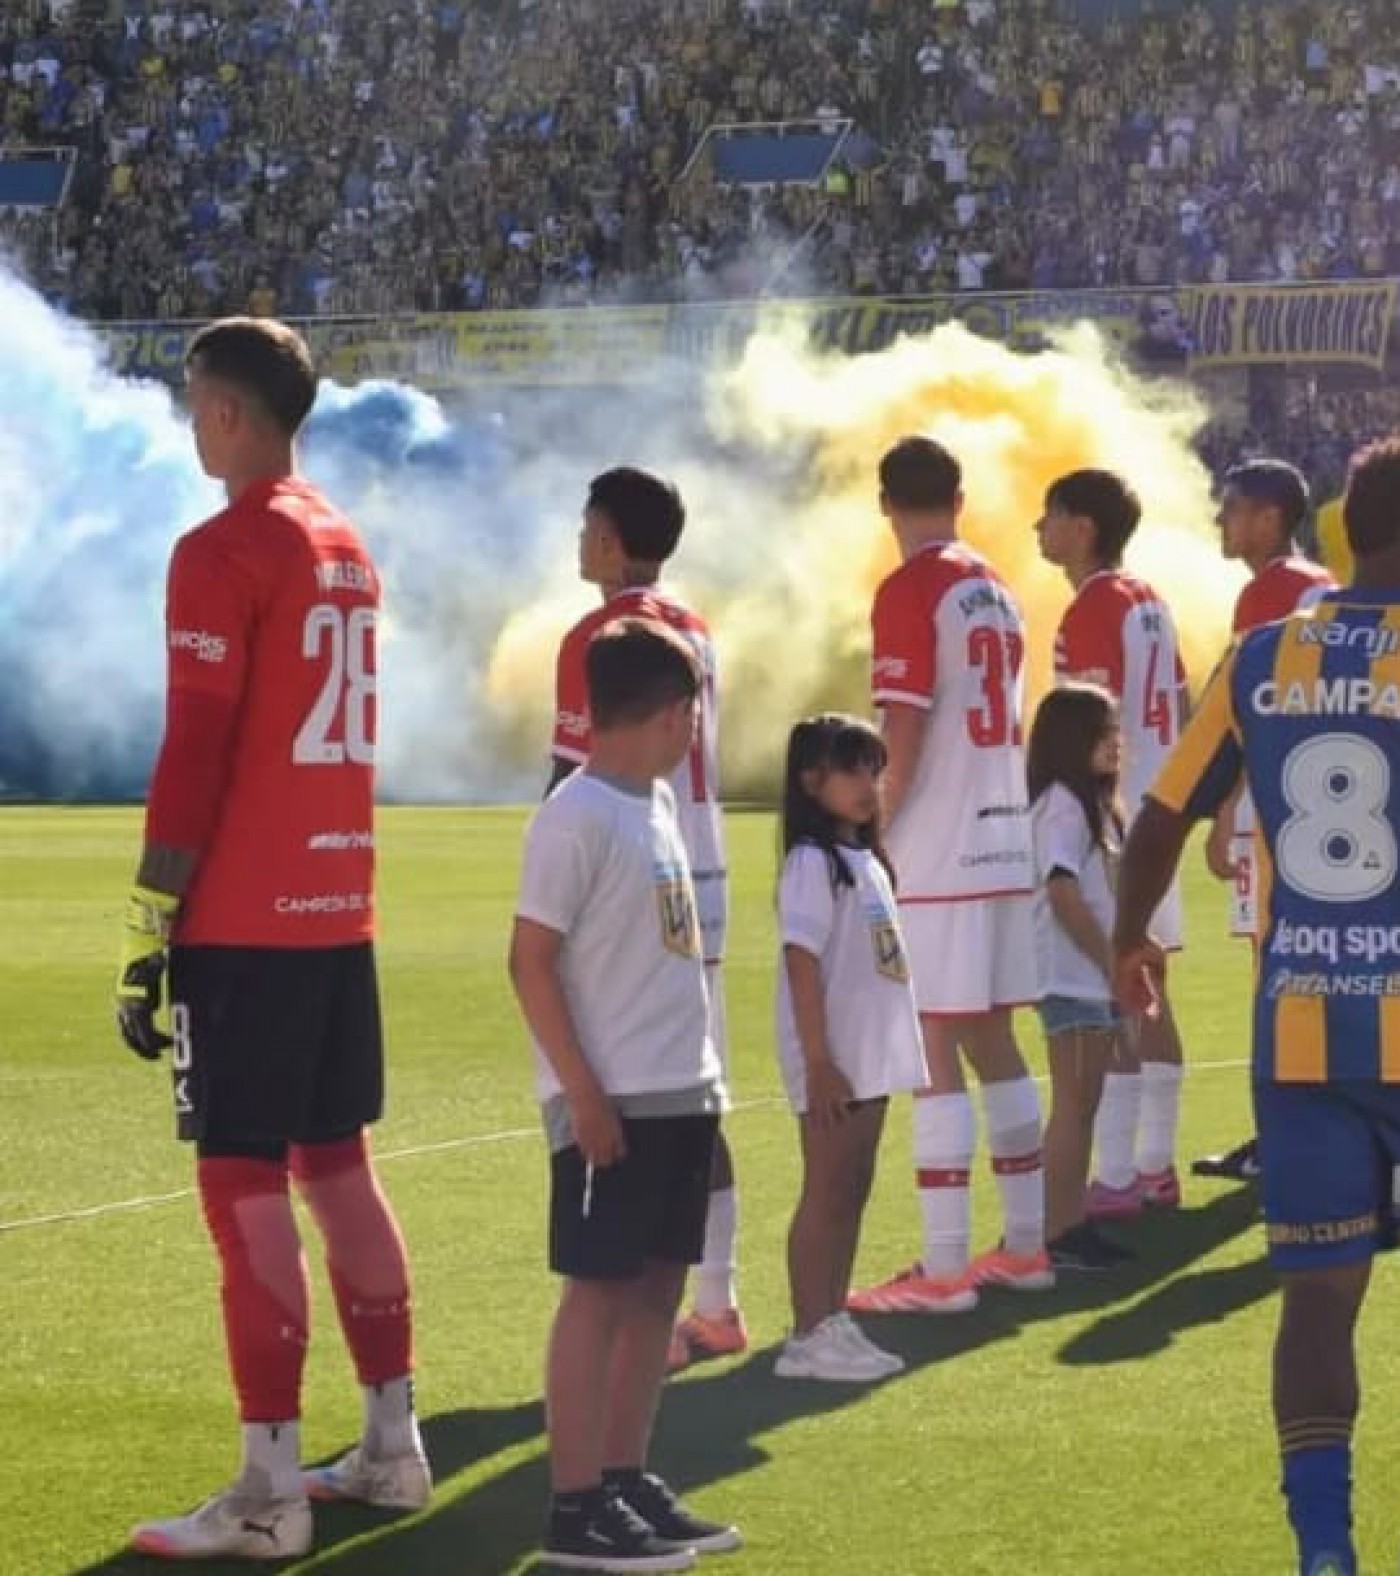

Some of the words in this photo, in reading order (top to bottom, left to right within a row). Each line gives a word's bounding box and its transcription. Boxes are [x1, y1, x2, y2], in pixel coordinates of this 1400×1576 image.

[290, 604, 377, 767] 28
[1299, 620, 1400, 659] kanji
[1274, 730, 1399, 903] 8
